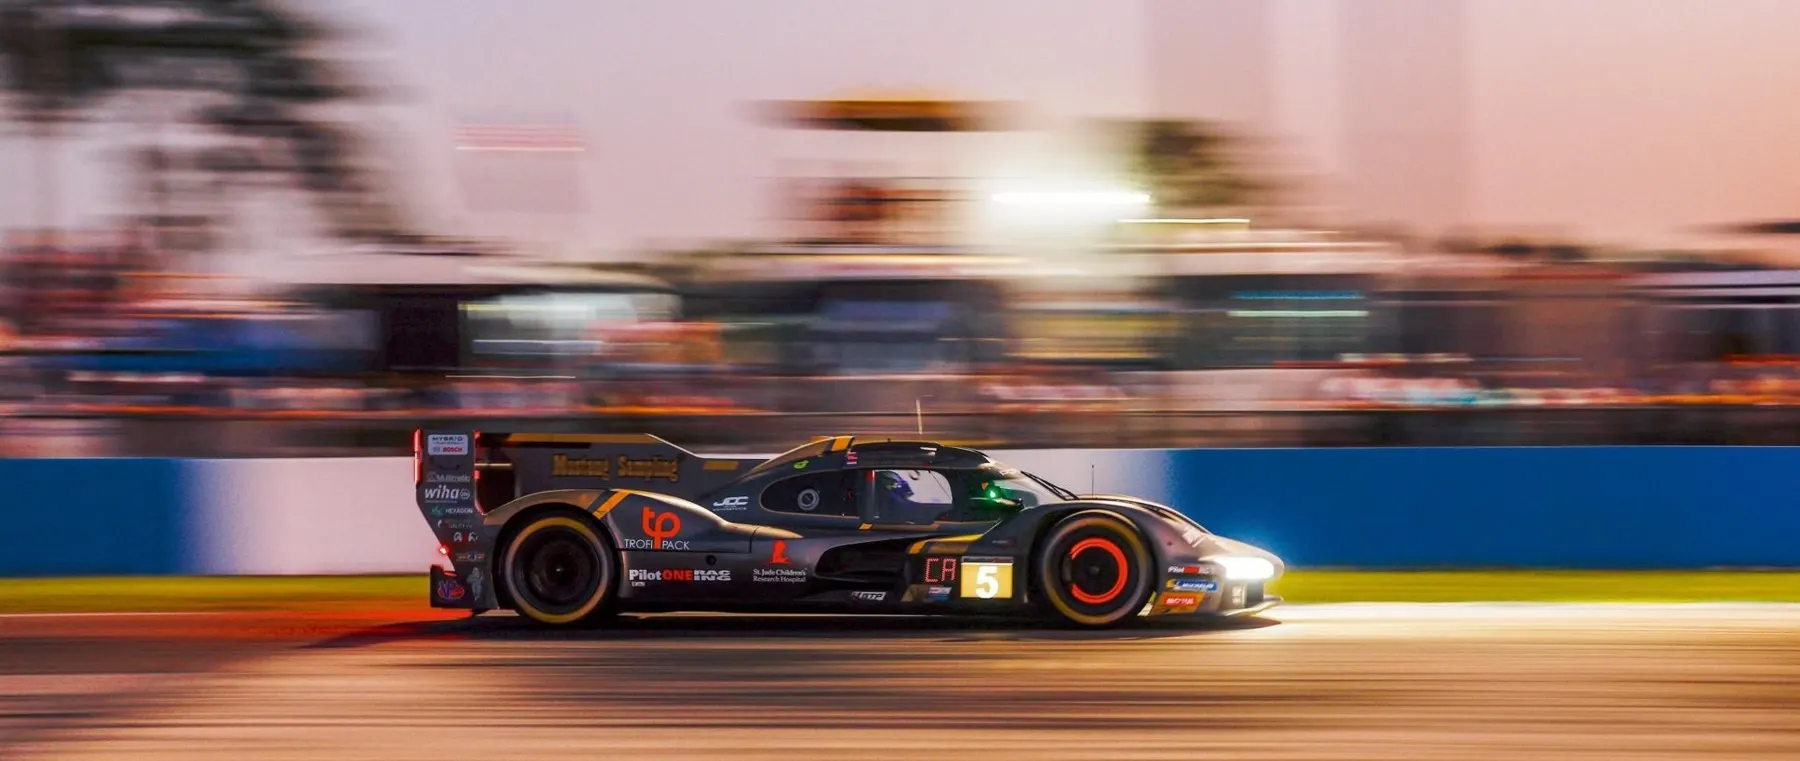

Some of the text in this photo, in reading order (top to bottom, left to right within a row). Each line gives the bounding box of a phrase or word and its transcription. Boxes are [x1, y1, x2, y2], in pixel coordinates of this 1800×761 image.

[424, 484, 460, 499] wiha
[625, 539, 690, 550] TROFI PACK
[925, 558, 957, 582] CA
[976, 565, 999, 599] 5
